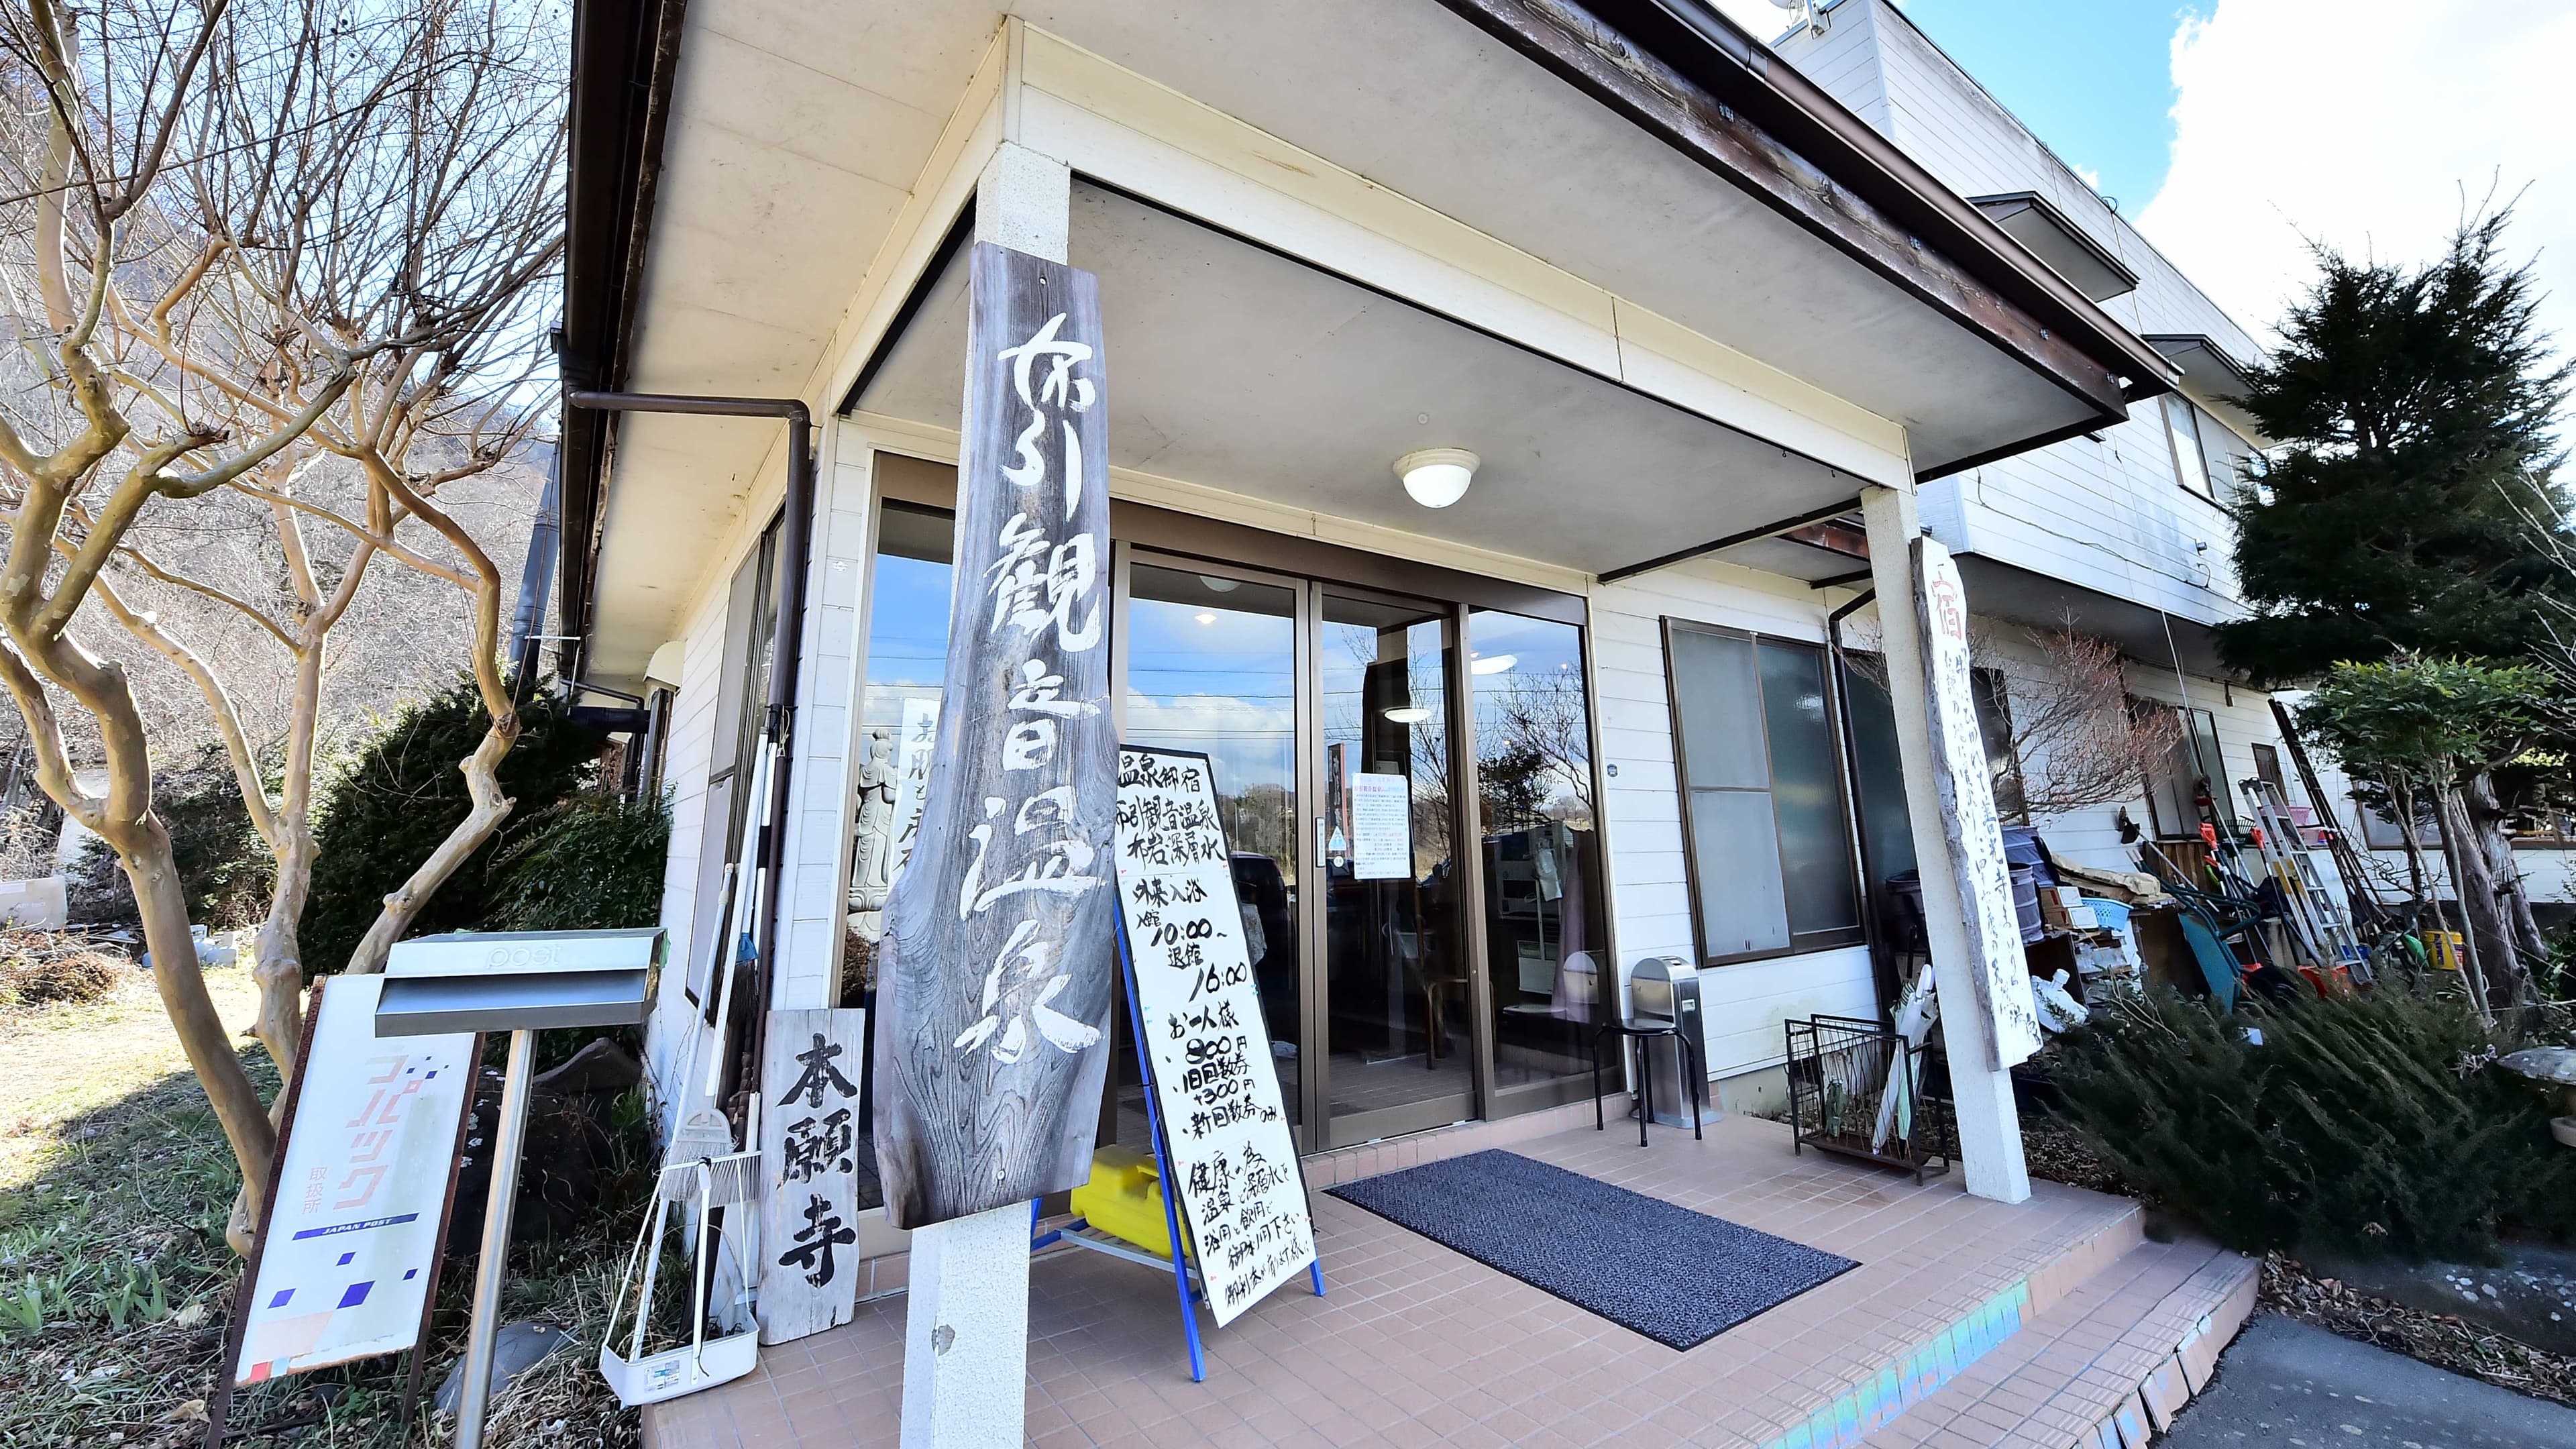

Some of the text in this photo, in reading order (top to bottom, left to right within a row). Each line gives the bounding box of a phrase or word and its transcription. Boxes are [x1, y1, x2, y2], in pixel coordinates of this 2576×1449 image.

[953, 313, 1104, 1063] 布引観音温泉
[1133, 875, 1208, 908] 外来入浴
[1136, 910, 1161, 930] 入館
[484, 945, 563, 969] post
[1168, 943, 1204, 970] 退館
[1189, 961, 1247, 1003] 16:00
[1168, 998, 1239, 1040] お一人様
[776, 1032, 858, 1288] 本願寺
[302, 1166, 329, 1215] 取扱所
[322, 1218, 393, 1235] JAPAN POST
